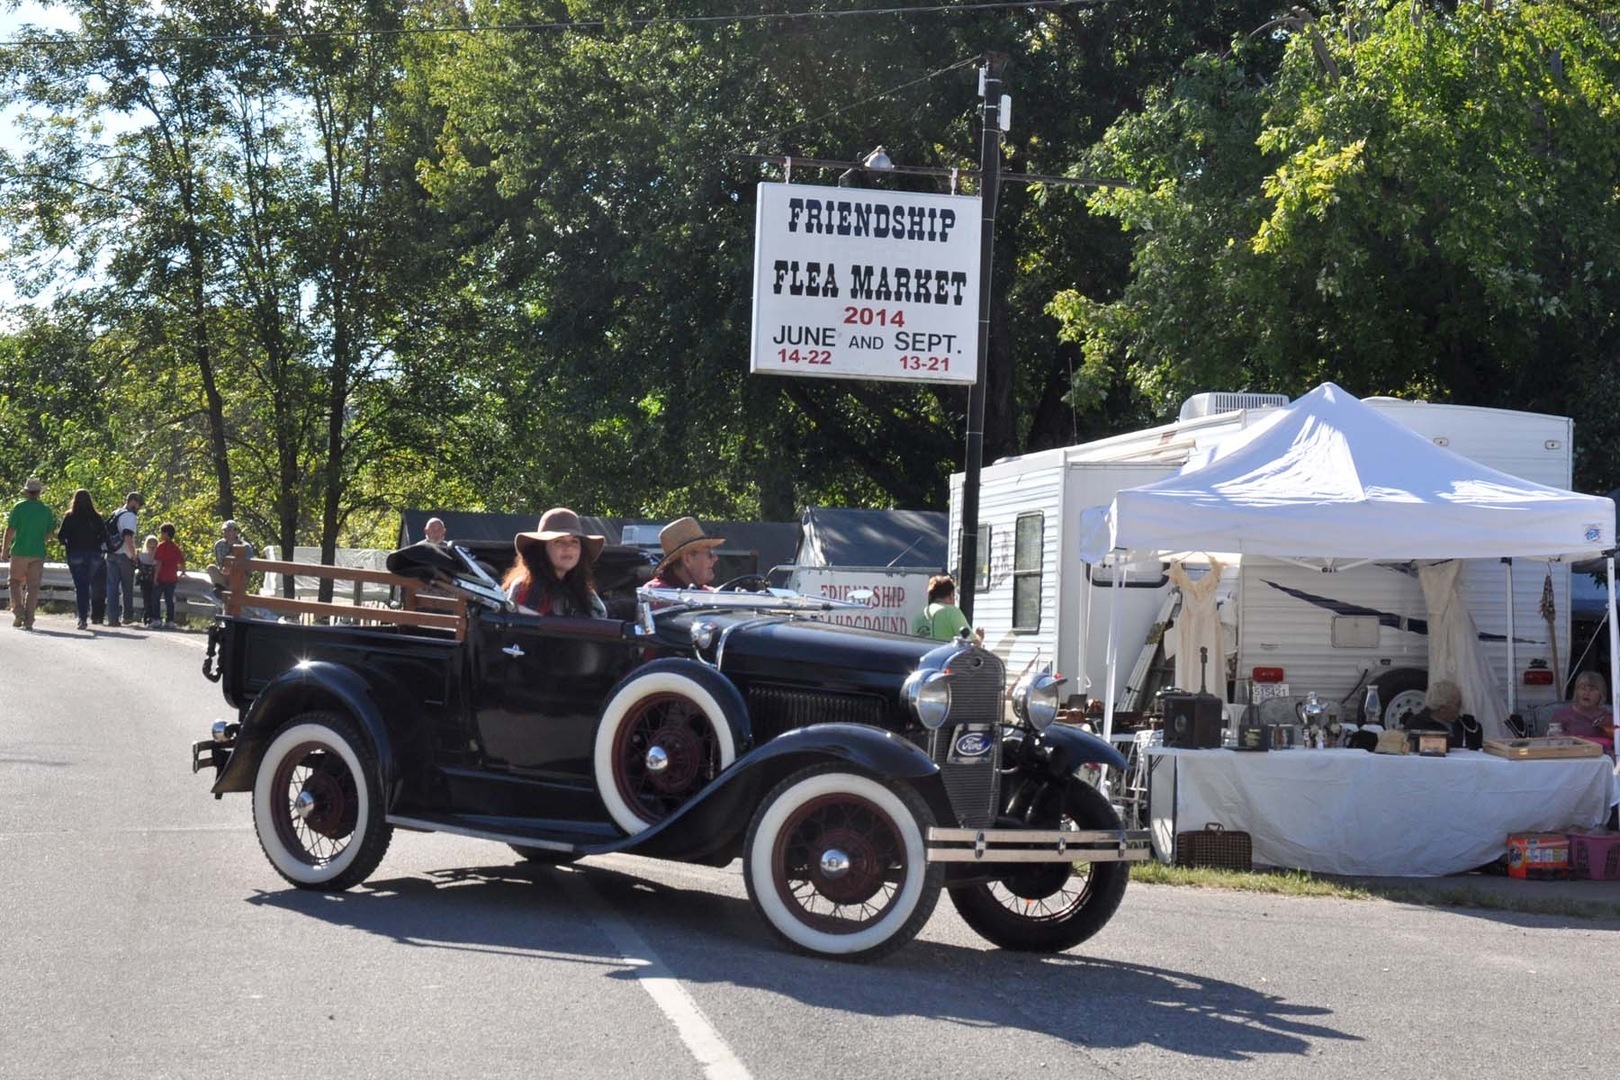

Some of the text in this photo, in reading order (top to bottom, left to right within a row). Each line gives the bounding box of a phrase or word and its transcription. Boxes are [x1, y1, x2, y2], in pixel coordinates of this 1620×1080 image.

[788, 198, 956, 242] FRIENDSHIP
[773, 260, 967, 305] FLEA MARKET
[843, 306, 905, 327] 2014
[773, 325, 962, 354] JUNE AND SEPT.
[778, 348, 950, 372] 14-22 13-21
